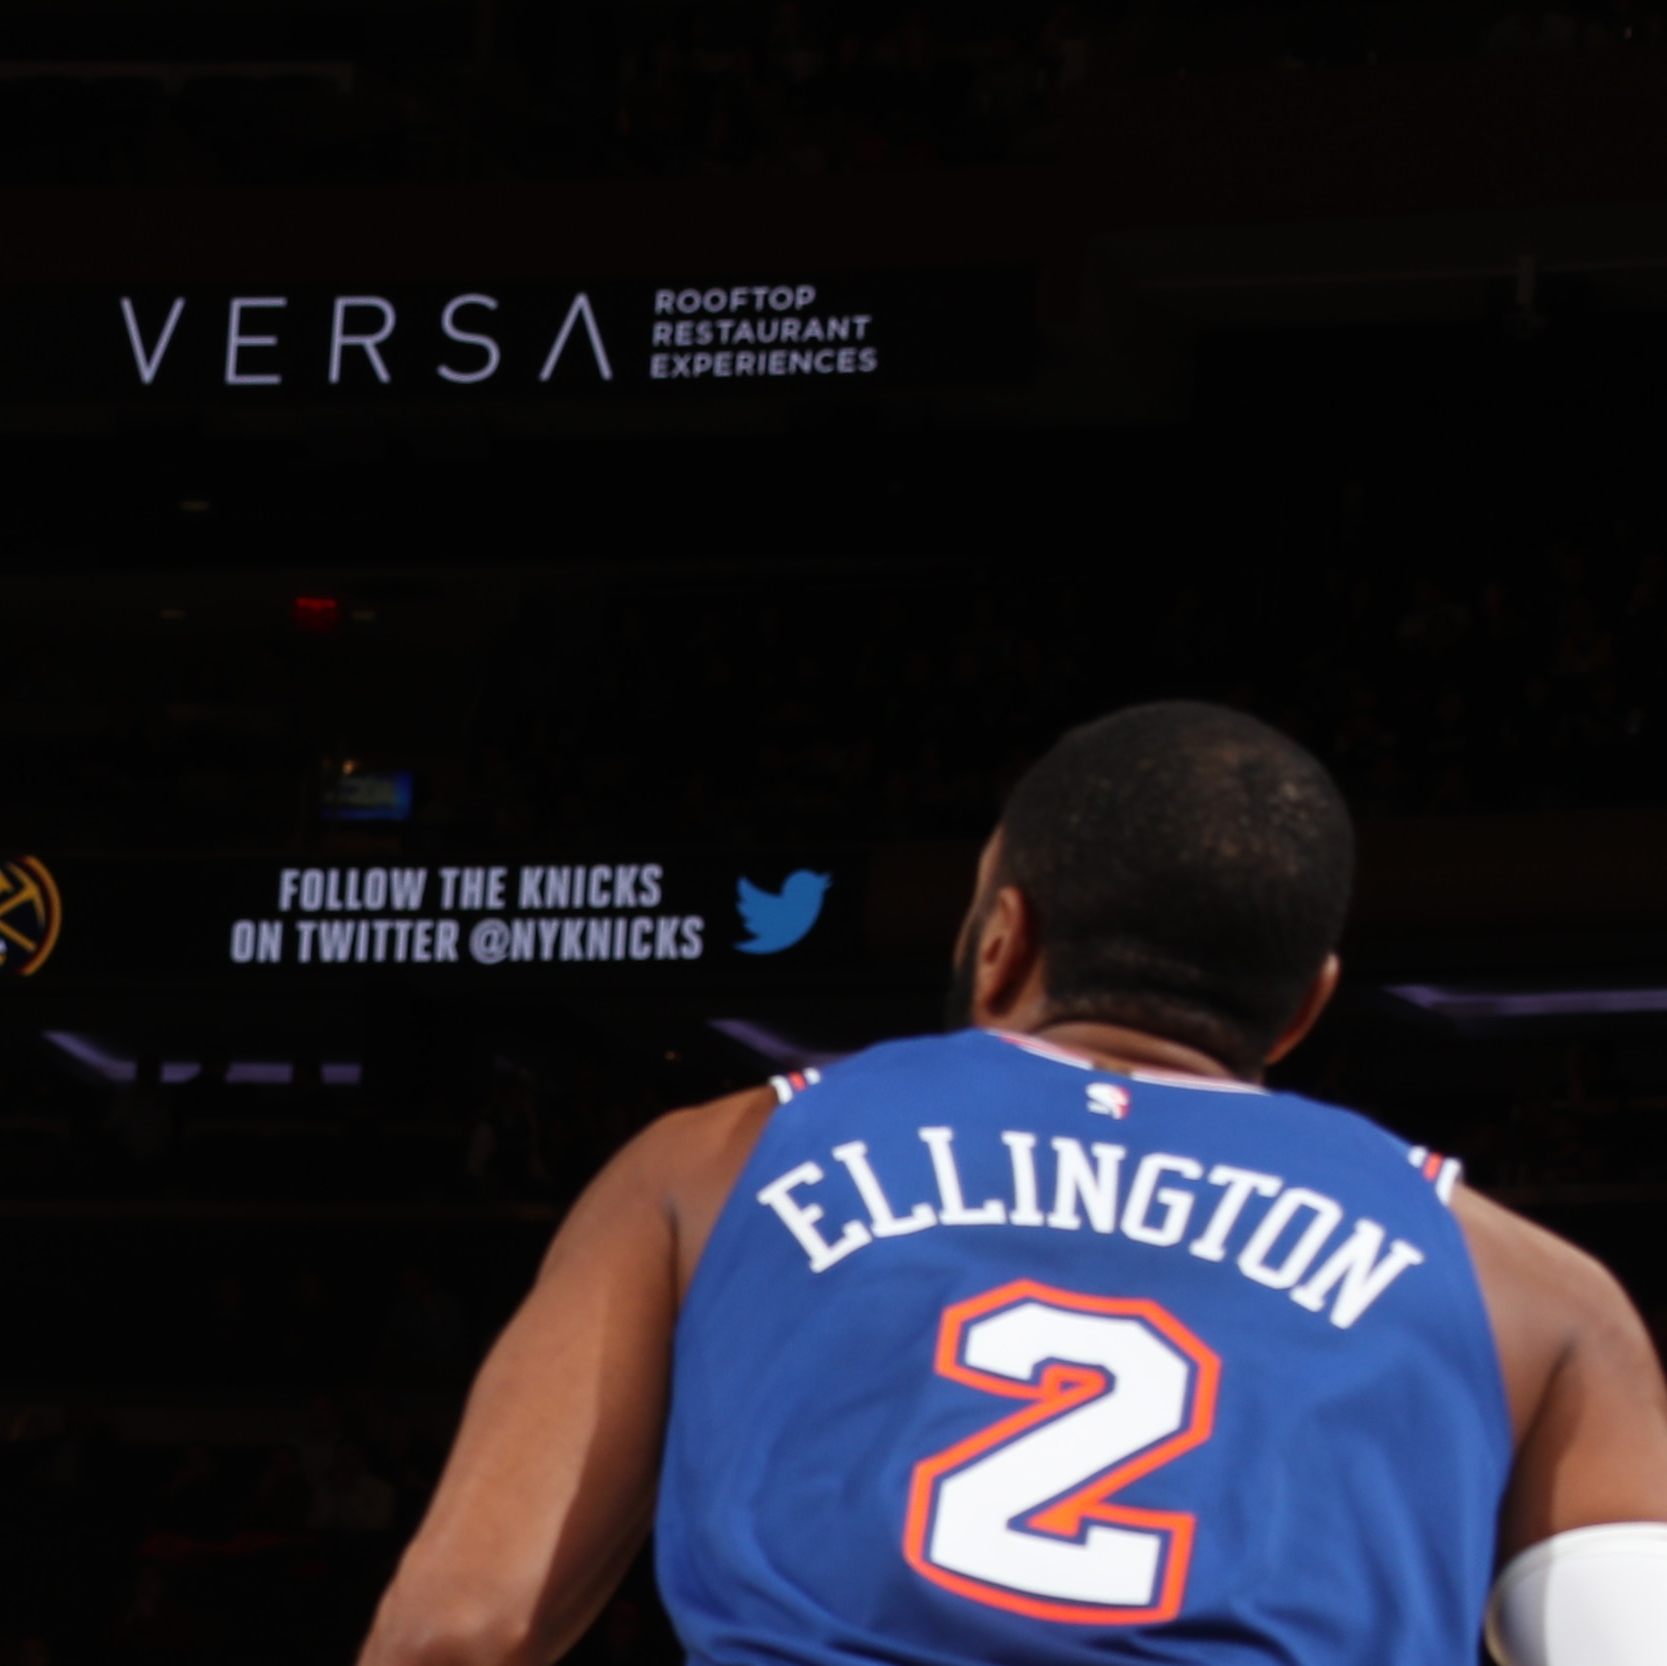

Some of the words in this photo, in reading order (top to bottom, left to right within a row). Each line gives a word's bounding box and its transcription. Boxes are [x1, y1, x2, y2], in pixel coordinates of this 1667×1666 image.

[653, 285, 817, 314] ROOFTOP
[120, 293, 614, 385] VERSA
[651, 315, 872, 347] RESTAURANT
[649, 347, 879, 380] EXPERIENCES
[279, 867, 428, 912] FOLLOW
[439, 867, 507, 911] THE
[518, 864, 663, 910] KNICKS
[230, 919, 283, 963] ON
[296, 919, 460, 963] TWITTER
[469, 916, 705, 965] @NYKNICKS
[758, 1126, 1424, 1330] ELLINGTON
[904, 1278, 1222, 1625] 2
